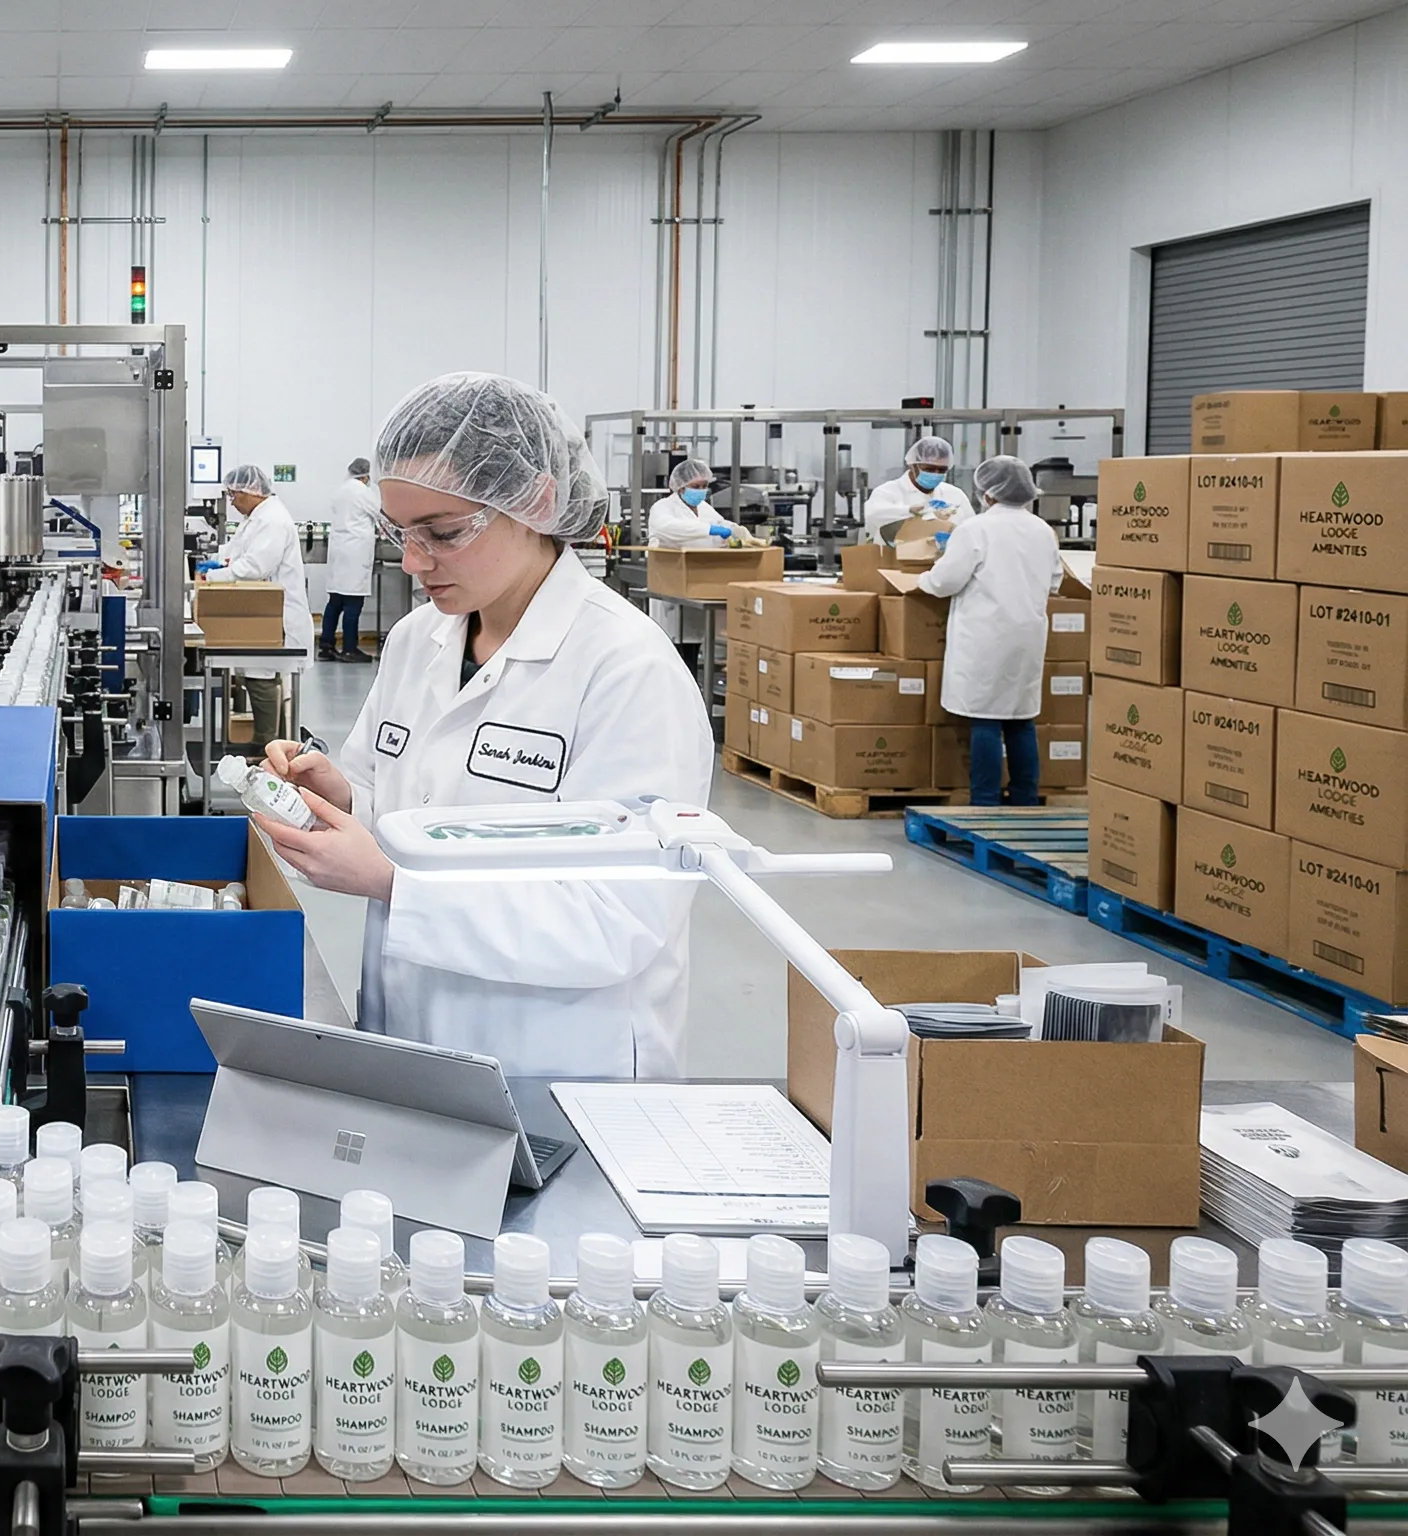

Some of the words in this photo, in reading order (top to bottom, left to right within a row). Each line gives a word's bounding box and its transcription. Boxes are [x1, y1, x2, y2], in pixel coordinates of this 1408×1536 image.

[1197, 475, 1217, 489] LOT
[1300, 511, 1384, 527] HEARTWOOD
[1321, 527, 1358, 540] LODGE
[1312, 543, 1367, 557] AMENITIES
[1096, 584, 1113, 596] LOT
[1310, 605, 1333, 620] LOT
[1336, 608, 1391, 627] #2410-01
[1199, 626, 1271, 645] HEARTWOOD
[1210, 656, 1258, 672] AMENITIES
[1192, 710, 1213, 727] LOT
[1105, 722, 1163, 746] HEARTWOOD
[1298, 769, 1380, 799] HEARTWOOD
[1318, 787, 1358, 807] LODGE
[1308, 802, 1365, 826] AMENITIES
[1194, 860, 1266, 893] HEARTWOOD
[1299, 859, 1324, 878] LOT
[1326, 866, 1381, 895] #2410-01
[1205, 894, 1252, 918] AMENITIES
[81, 1374, 142, 1386] EARTWO
[92, 1387, 130, 1399] LODGE
[179, 1383, 218, 1397] LODGE
[256, 1389, 295, 1401] LODGE
[835, 1387, 905, 1401] HEARTW
[932, 1388, 991, 1402] HEART
[343, 1393, 382, 1405] LODGE
[421, 1397, 463, 1409] LODGE
[507, 1400, 549, 1412] LODGE
[591, 1399, 633, 1412] LODGE
[676, 1400, 719, 1413] LODGE
[764, 1401, 807, 1414] LODGE
[855, 1401, 896, 1413] LODGE
[85, 1409, 137, 1424] SHAMPOO
[172, 1406, 222, 1422] SHAMPOO
[250, 1412, 302, 1426] SHAMPOO
[335, 1416, 388, 1430] SHAMPOO
[415, 1419, 469, 1435] SHAMPOO
[584, 1421, 639, 1437] SHAMPOO
[667, 1422, 724, 1439] SHAMPOO
[756, 1424, 812, 1440] SHAMPOO
